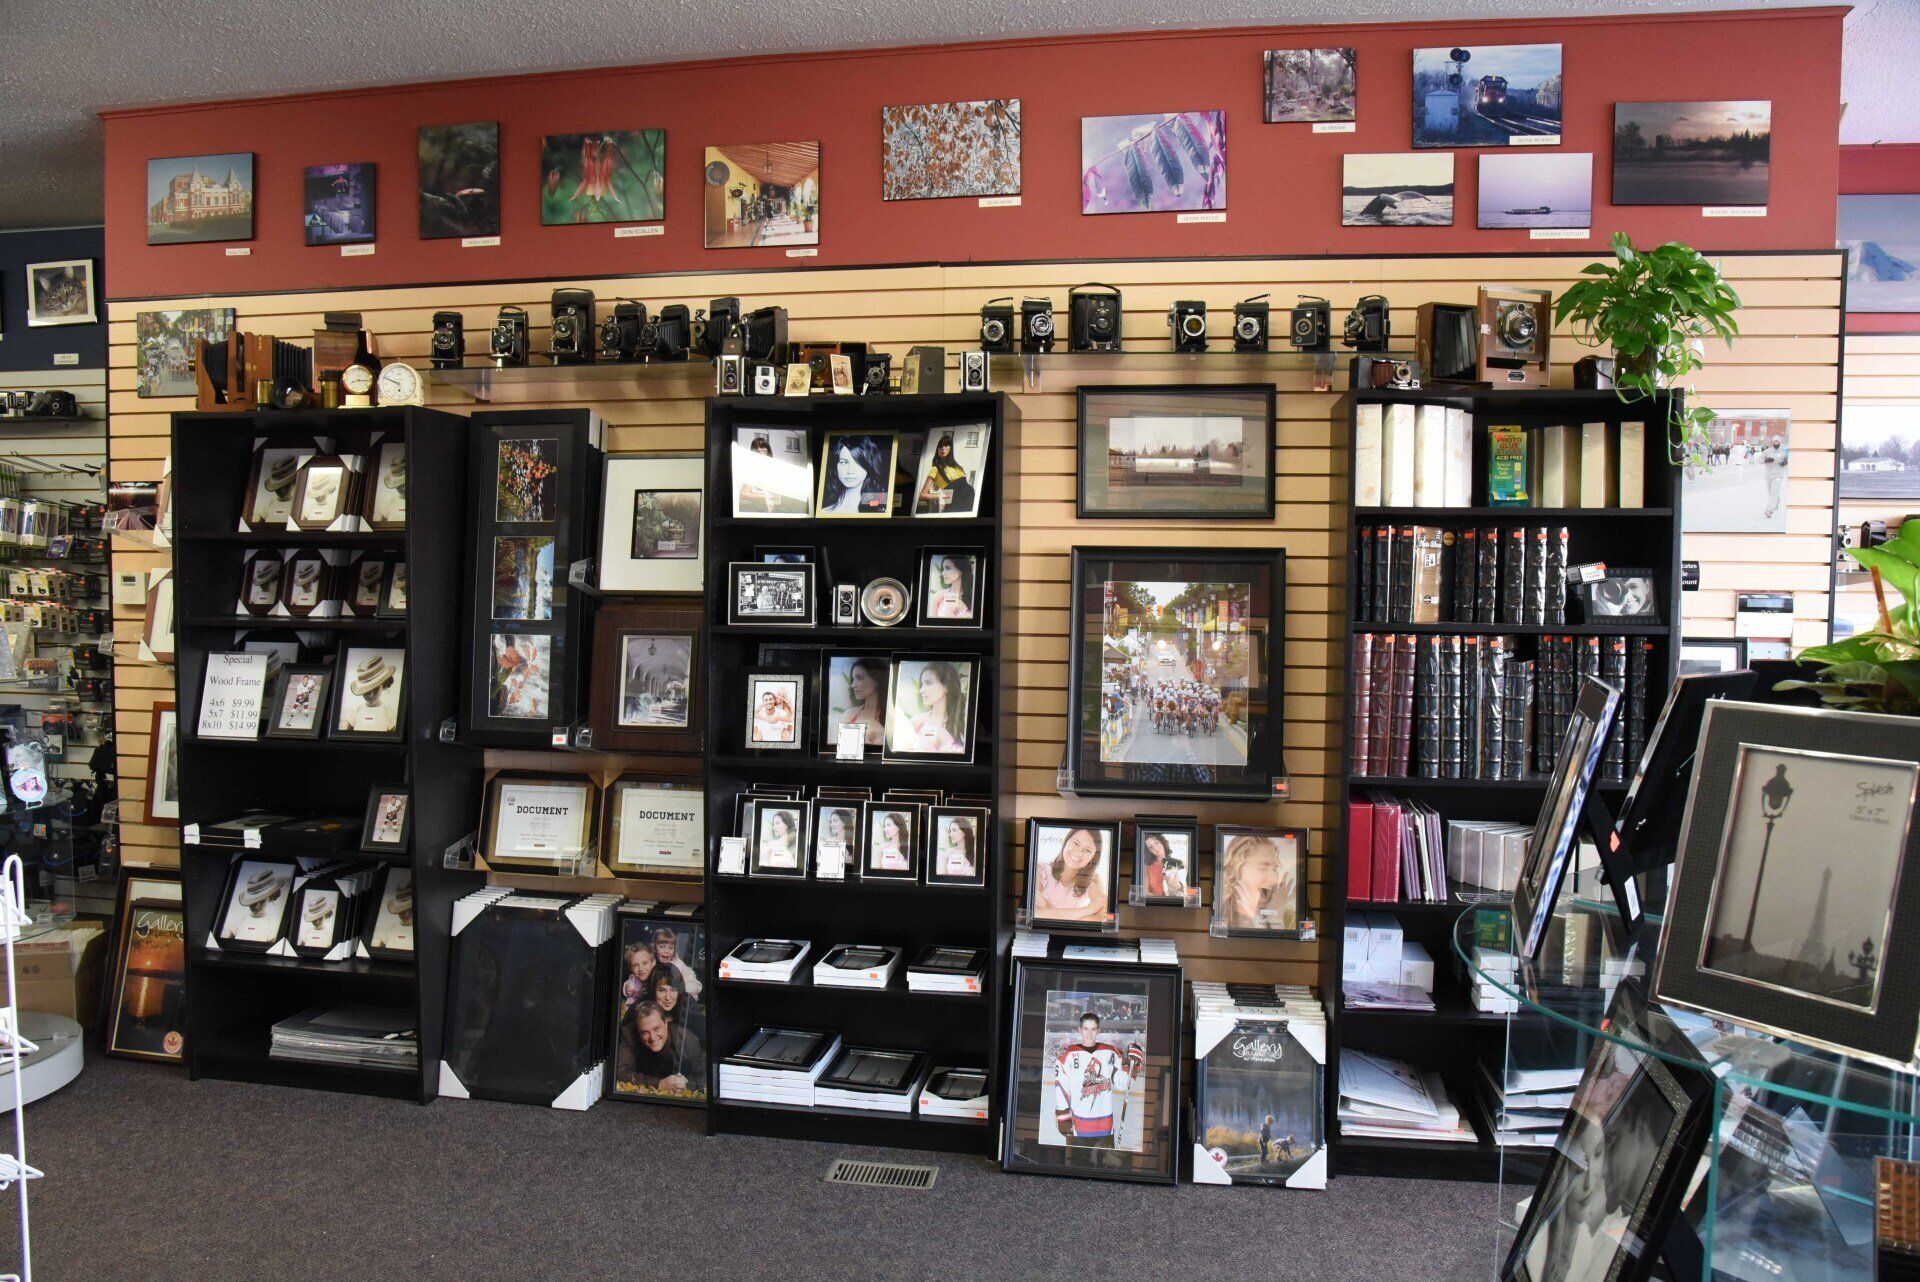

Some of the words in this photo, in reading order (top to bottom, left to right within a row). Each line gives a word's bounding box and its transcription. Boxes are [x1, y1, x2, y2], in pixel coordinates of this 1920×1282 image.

[223, 653, 253, 666] Special
[210, 676, 234, 686] Wood
[235, 676, 261, 687] Frame
[209, 698, 225, 707] 4x6
[232, 698, 255, 708] $9.99
[208, 708, 224, 718] 5x7
[230, 709, 258, 719] $11.99
[201, 720, 222, 729] 8x10
[229, 720, 257, 730] $14.99
[516, 805, 569, 816] DOCUMENT
[639, 810, 696, 822] DOCUMENT
[1232, 1036, 1283, 1060] Gallery
